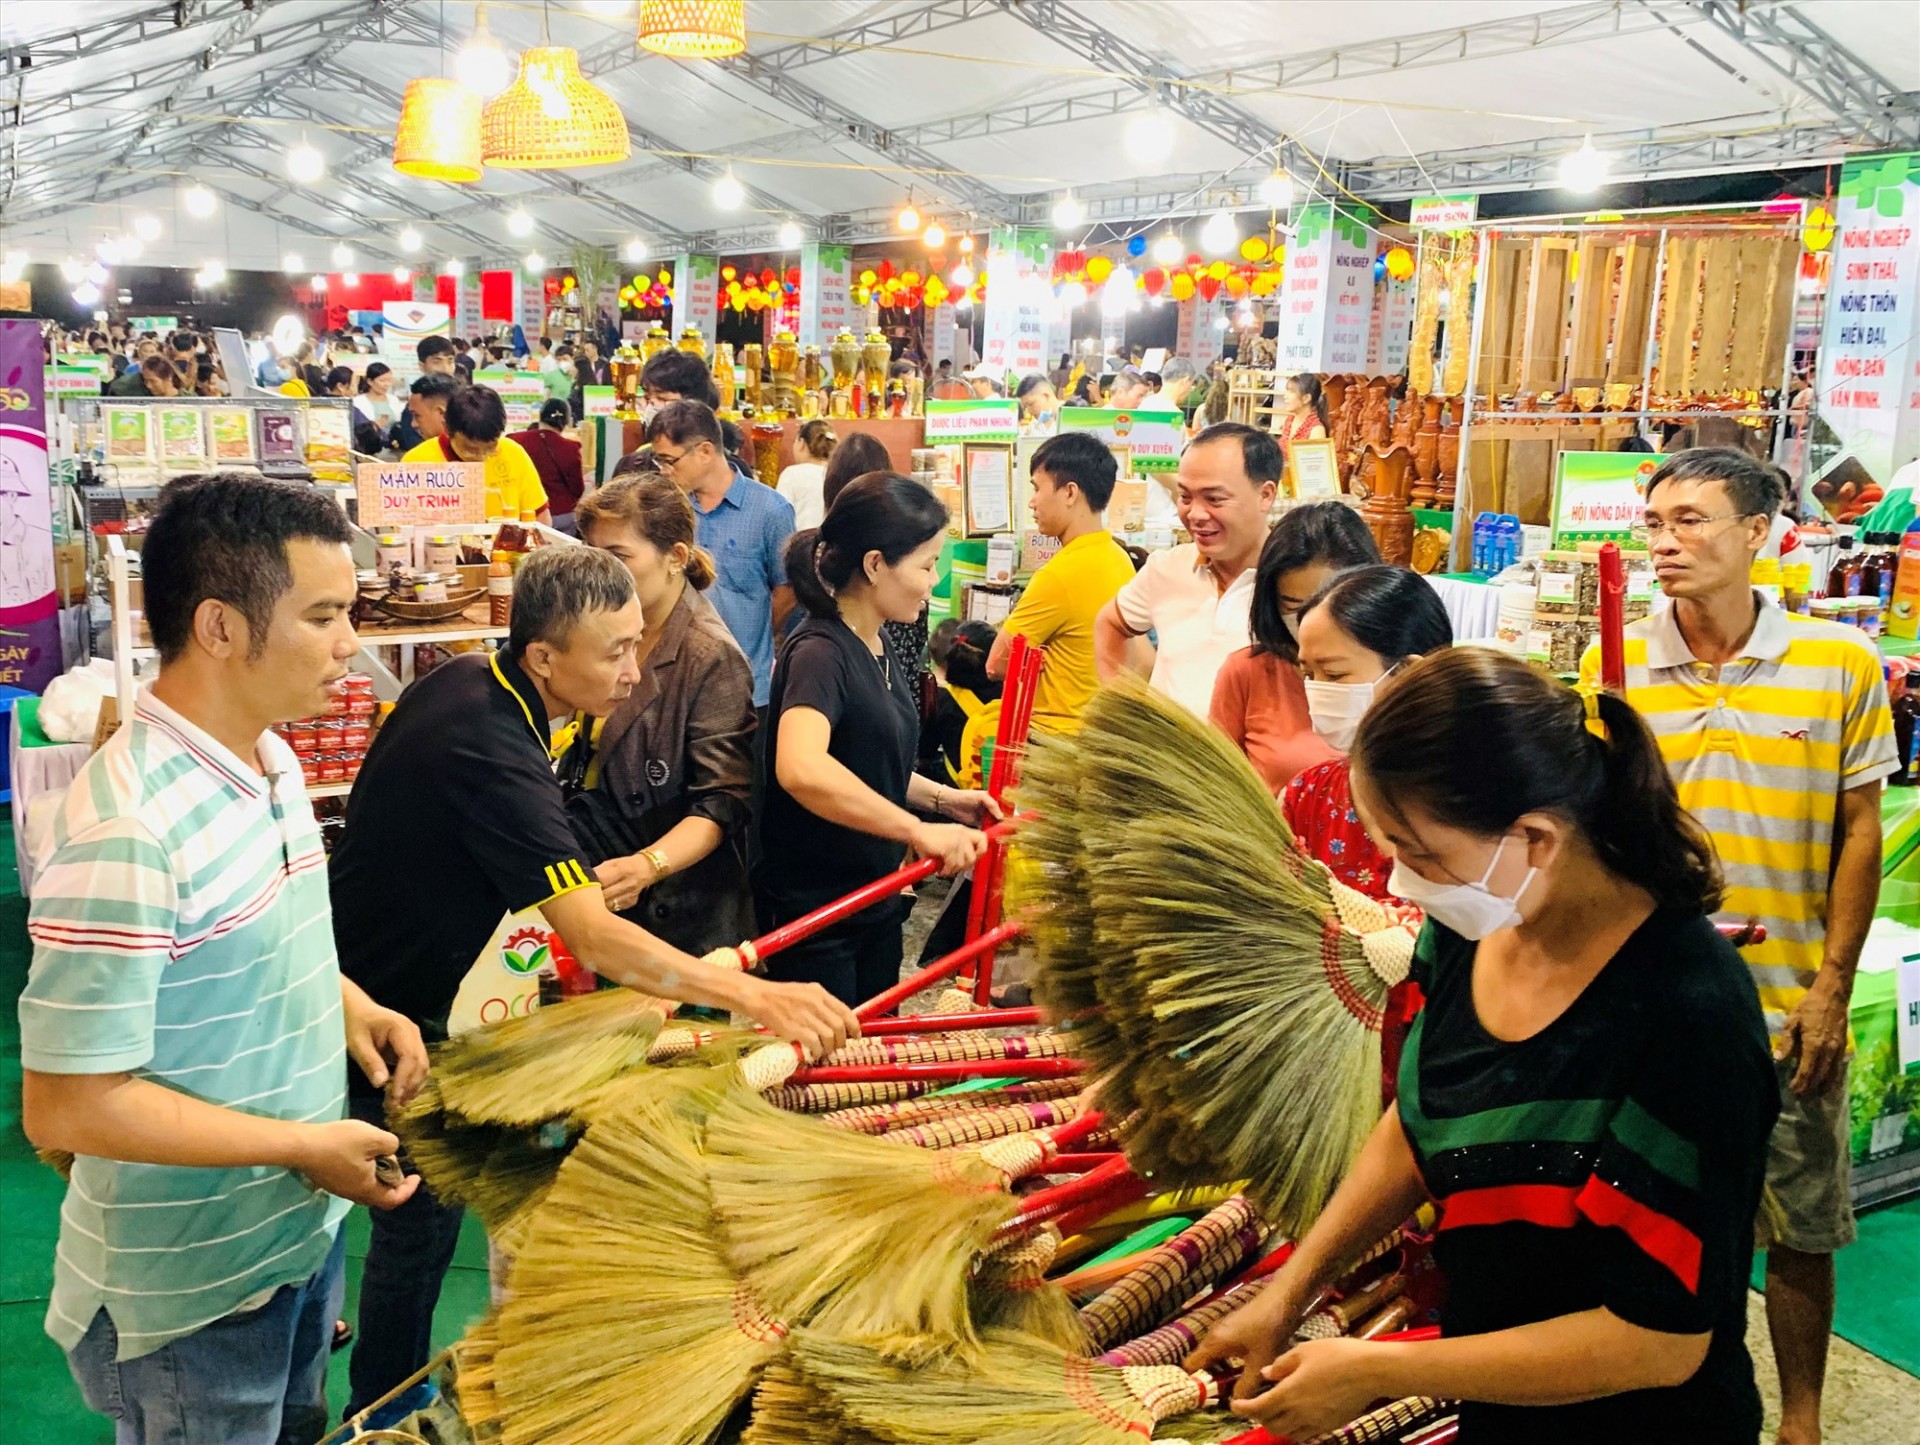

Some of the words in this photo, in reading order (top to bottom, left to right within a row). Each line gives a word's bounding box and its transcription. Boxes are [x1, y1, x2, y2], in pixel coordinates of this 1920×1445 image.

[1416, 214, 1440, 223] ANH
[1843, 226, 1870, 248] NÔNG
[1846, 262, 1870, 280] SINH
[1839, 290, 1866, 312] NÔNG
[1870, 290, 1898, 312] THÔN
[1840, 322, 1865, 348] HIỆN
[1834, 354, 1861, 376] NÔNG
[1864, 354, 1886, 376] DÂN
[380, 466, 420, 488] MẮM
[426, 466, 465, 488] RUỐC
[384, 495, 410, 508] DUY
[1571, 502, 1588, 521] HỘI
[1590, 502, 1613, 521] NÔNG
[1615, 502, 1633, 521] DÂN
